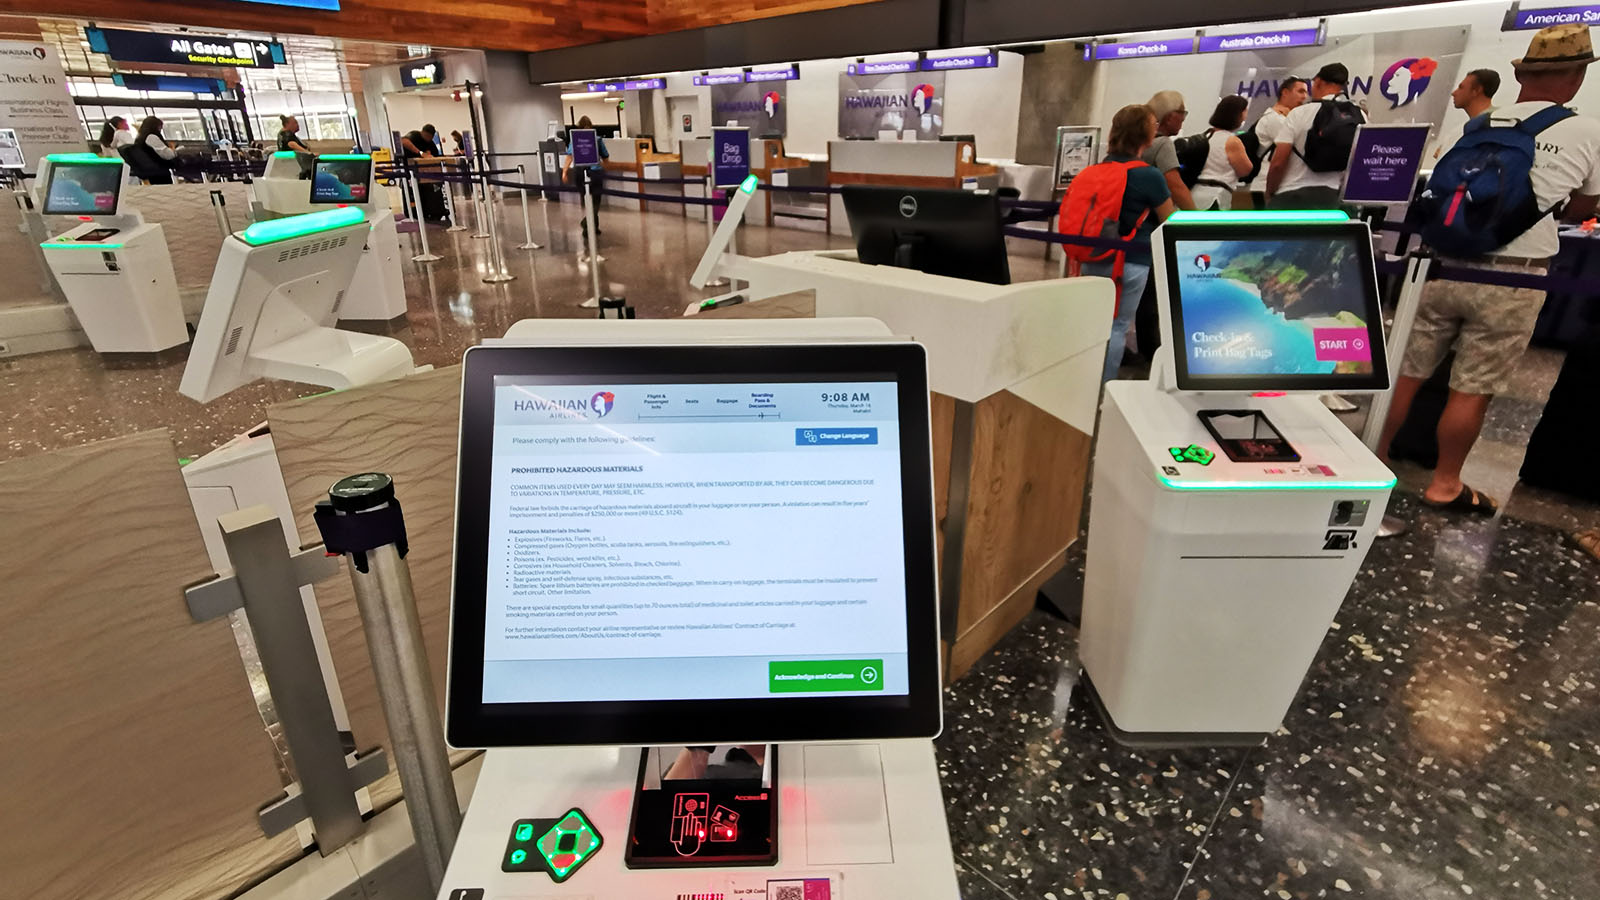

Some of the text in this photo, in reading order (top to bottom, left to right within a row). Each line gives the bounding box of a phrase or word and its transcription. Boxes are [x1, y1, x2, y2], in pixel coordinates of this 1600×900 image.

[1524, 12, 1580, 24] American
[171, 40, 233, 56] All Gates
[1220, 36, 1254, 48] Australia
[188, 54, 254, 66] Security Checkpoint
[724, 142, 740, 155] Bag
[1371, 144, 1403, 154] Please
[722, 153, 743, 165] Drop
[1363, 156, 1408, 165] wait here
[1320, 339, 1348, 350] START
[1194, 346, 1222, 358] Print
[1248, 346, 1273, 360] Tags
[821, 392, 870, 402] 9:08 AM
[514, 400, 588, 411] HAWAIIAN
